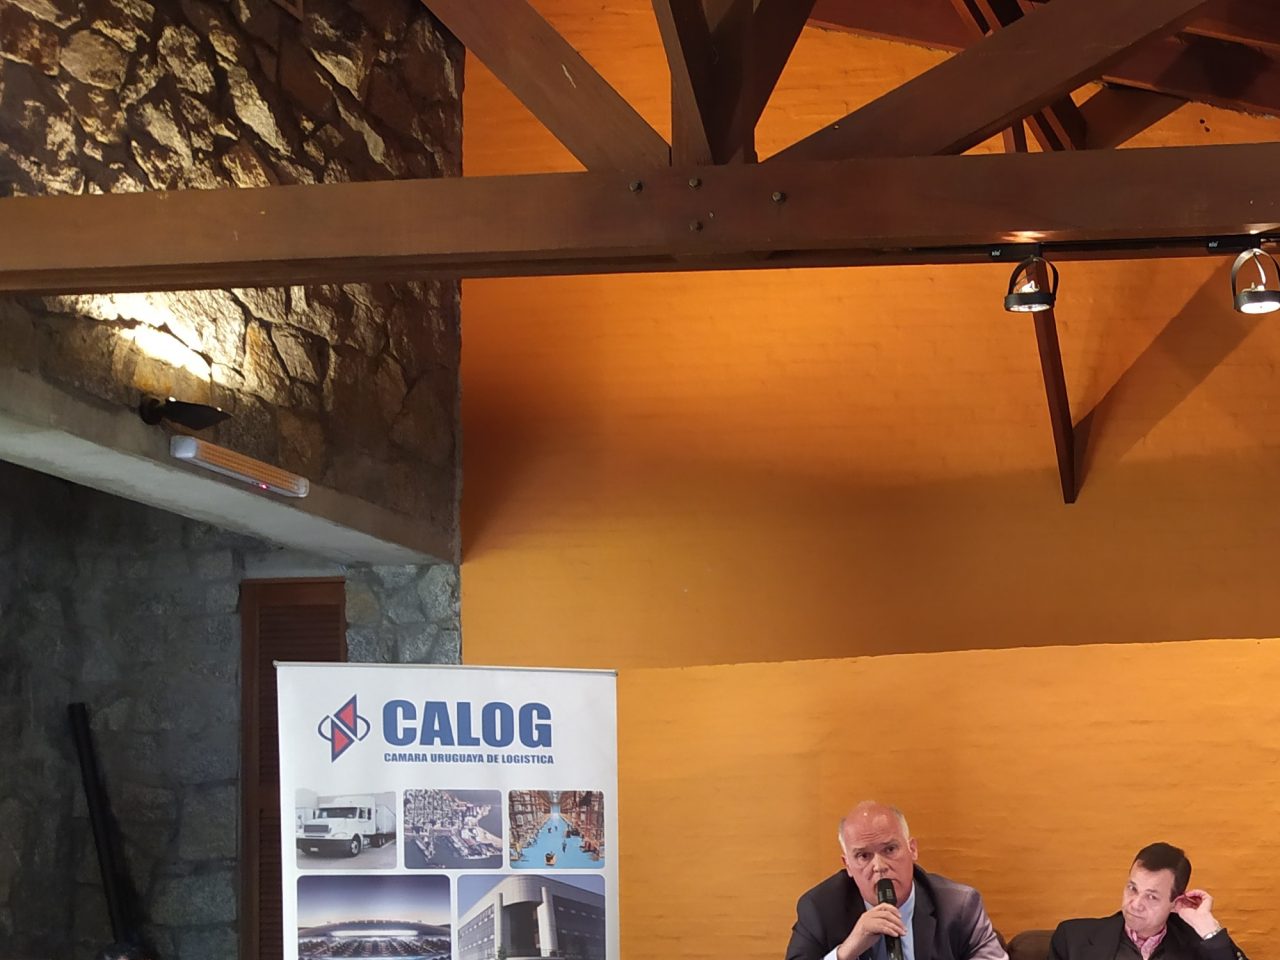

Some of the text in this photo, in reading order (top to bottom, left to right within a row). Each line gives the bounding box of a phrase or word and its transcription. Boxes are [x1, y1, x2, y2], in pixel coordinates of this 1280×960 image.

[383, 699, 552, 748] CALOG
[384, 752, 554, 764] CAMARA URUGUAYA DE LOGISTICA
